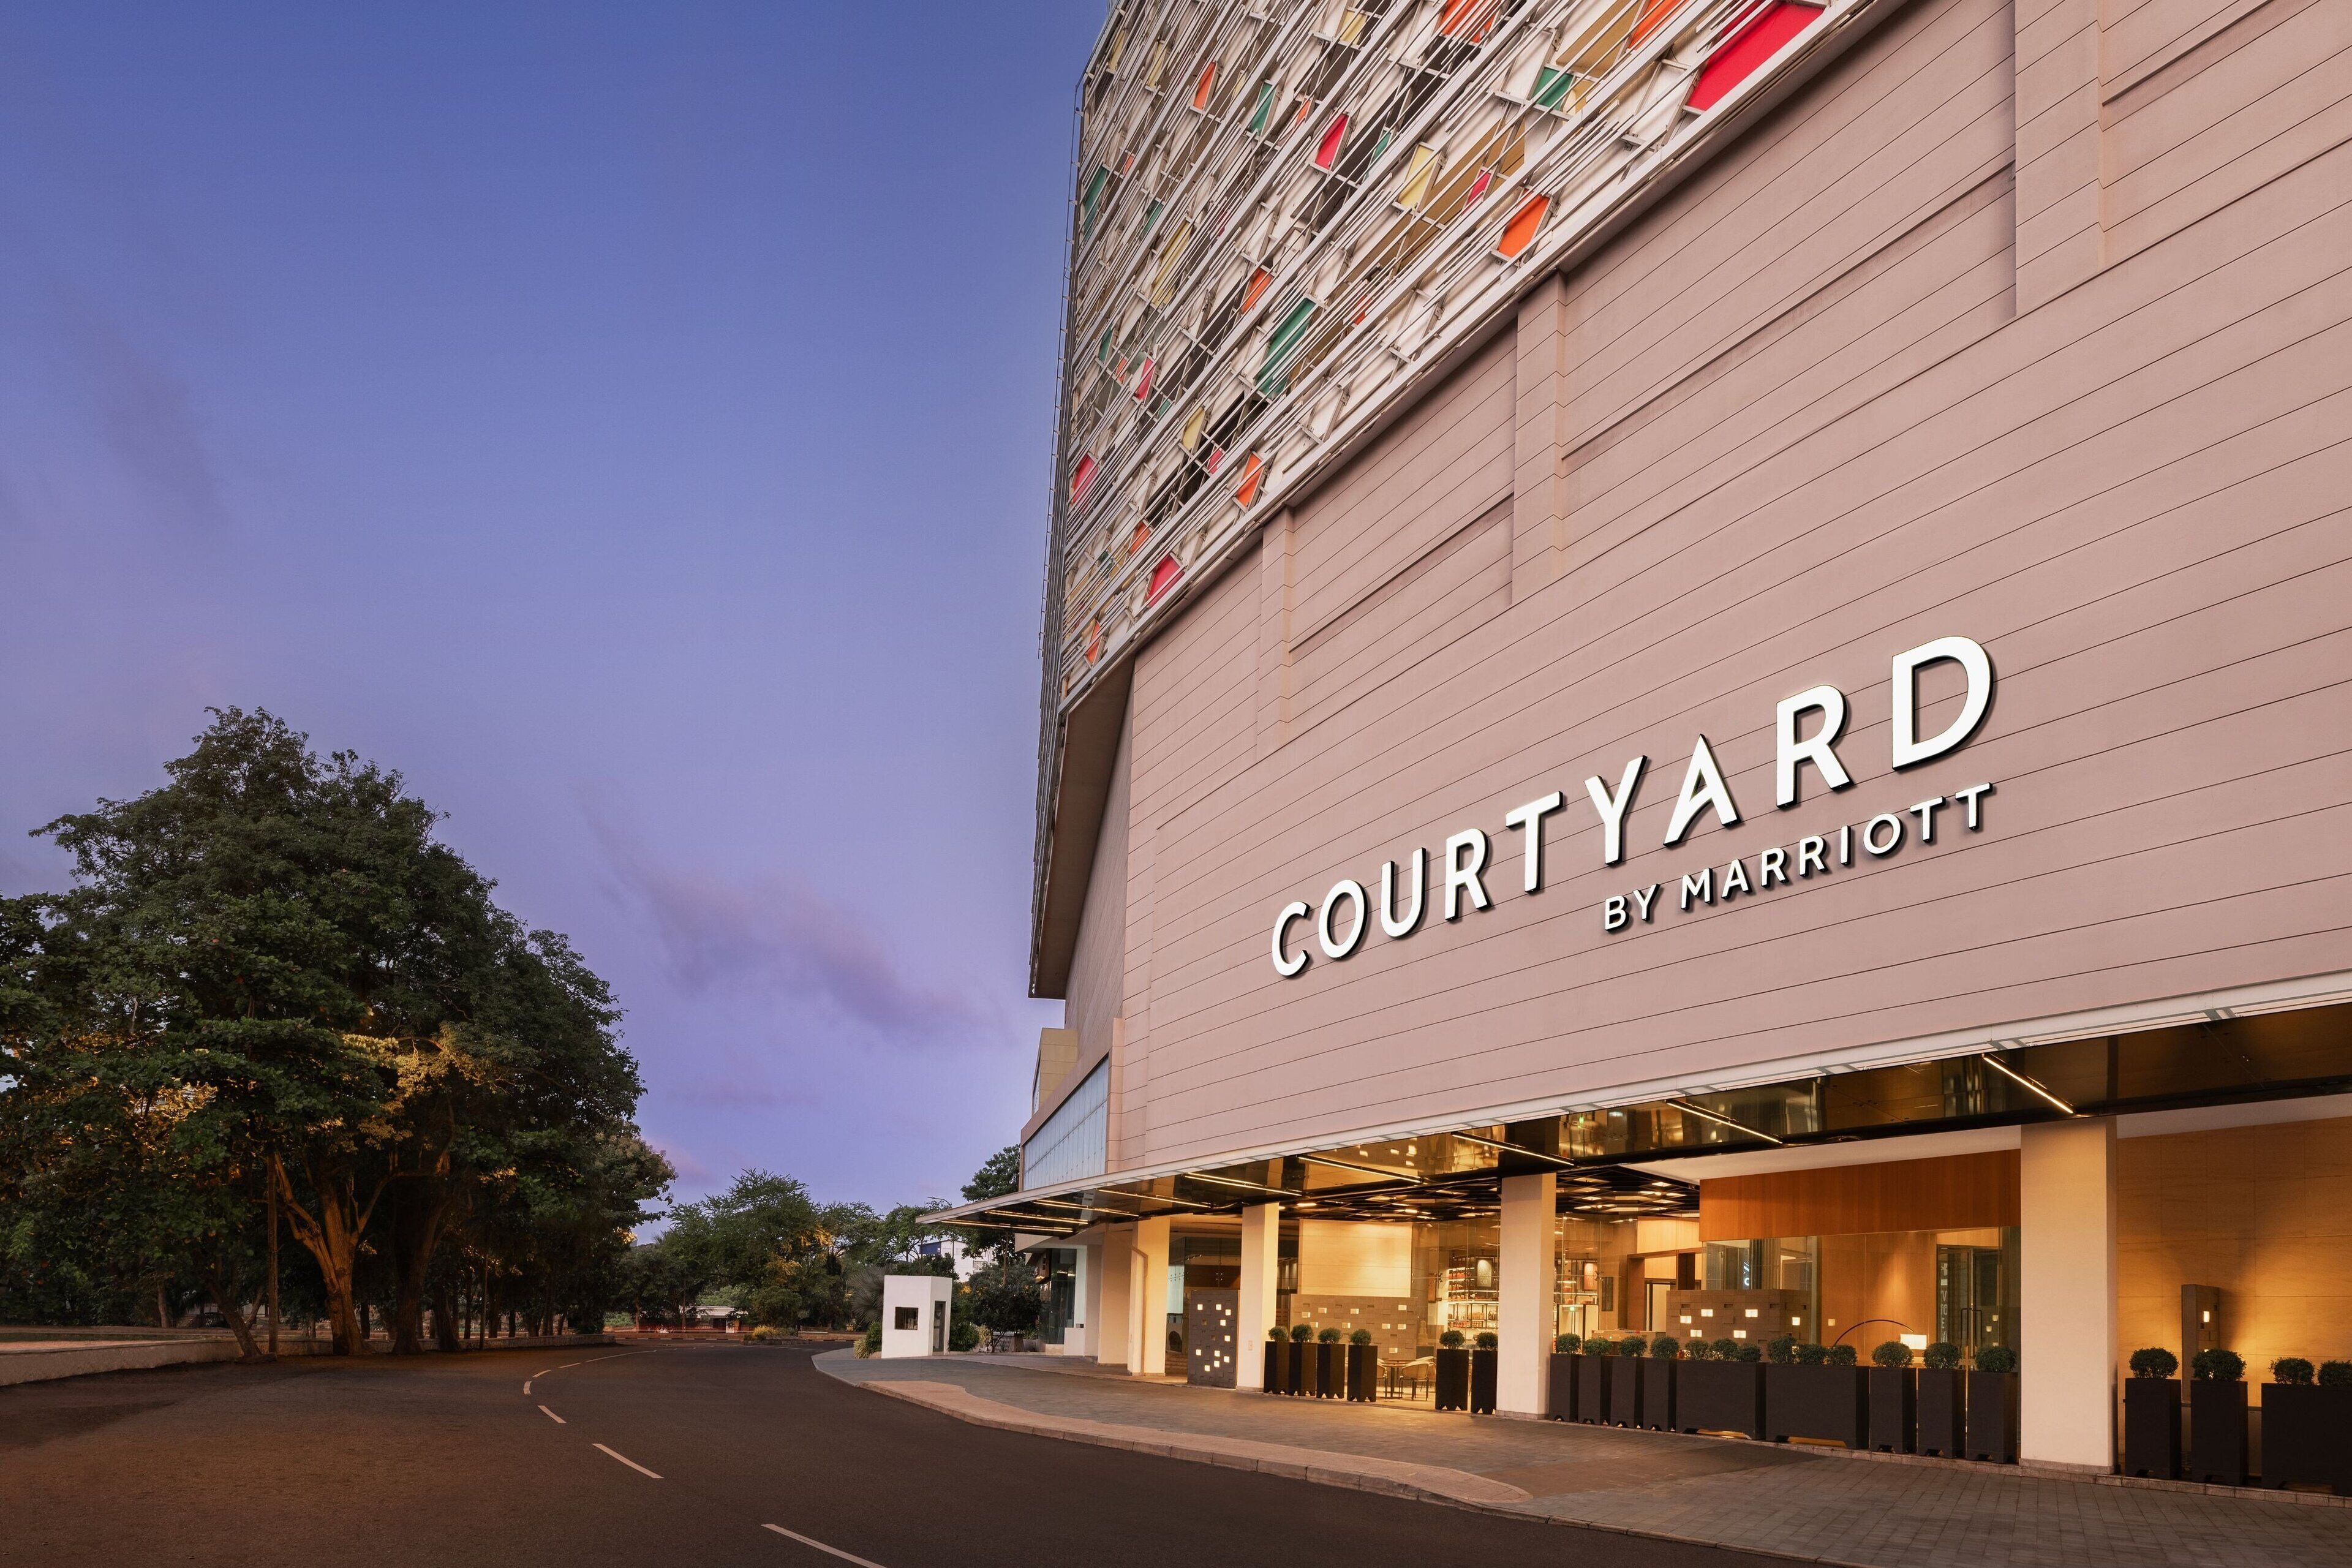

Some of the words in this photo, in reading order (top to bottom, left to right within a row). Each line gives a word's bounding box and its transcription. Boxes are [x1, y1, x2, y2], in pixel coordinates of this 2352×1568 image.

[1271, 635, 1993, 978] COURTYARD
[1604, 883, 1658, 932] BY
[1680, 782, 1992, 910] MARRIOTT
